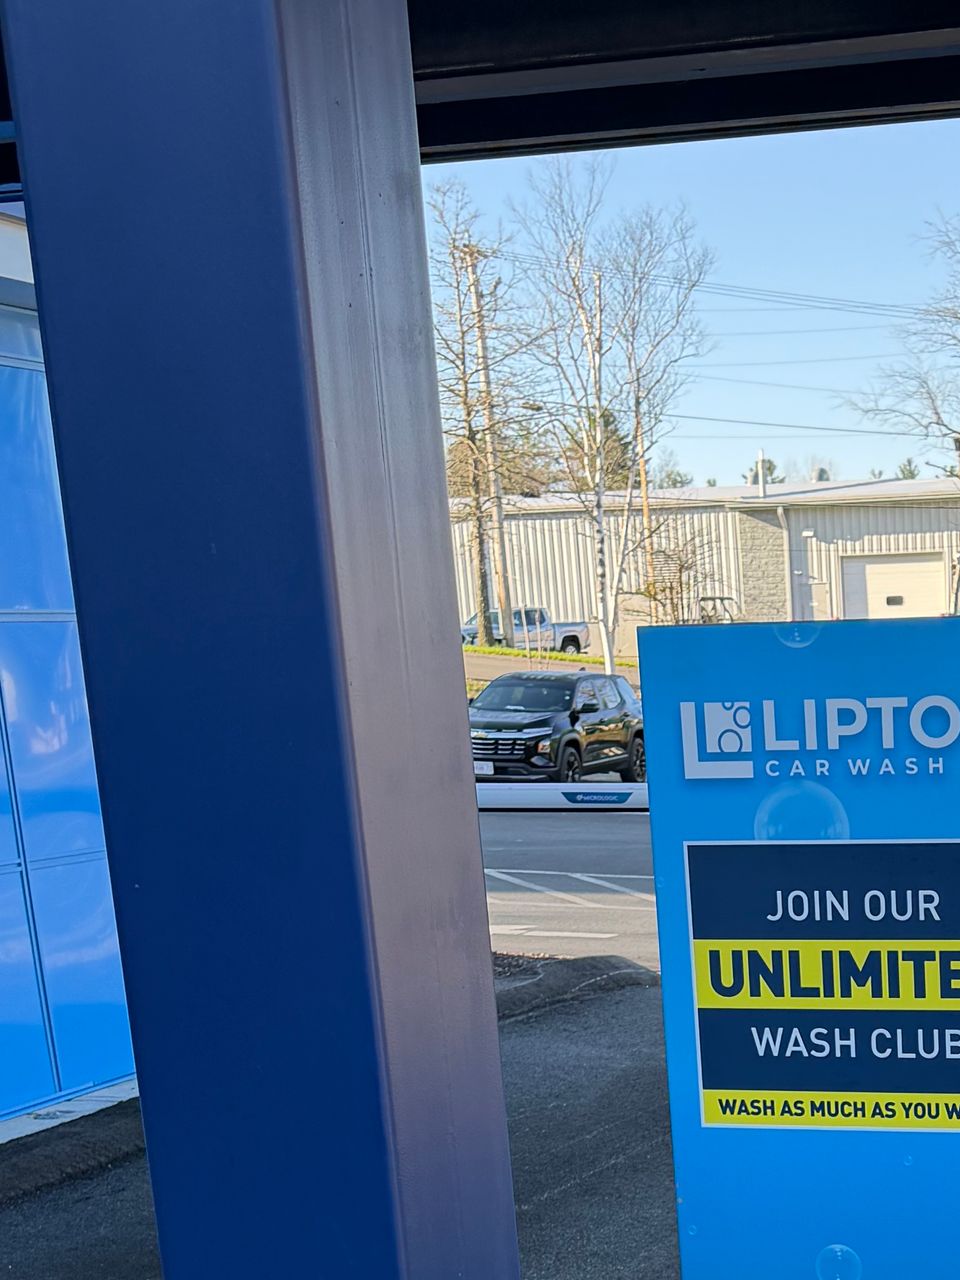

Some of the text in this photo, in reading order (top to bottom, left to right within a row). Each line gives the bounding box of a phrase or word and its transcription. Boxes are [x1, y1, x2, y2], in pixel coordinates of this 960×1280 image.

[765, 757, 944, 777] CAR WASH
[766, 889, 942, 922] JOIN OUR
[750, 1026, 857, 1059] WASH
[717, 1098, 776, 1116] WASH
[780, 1100, 805, 1117] AS
[810, 1100, 866, 1119] MUCH
[871, 1102, 897, 1119] AS
[901, 1102, 941, 1119] YOU
